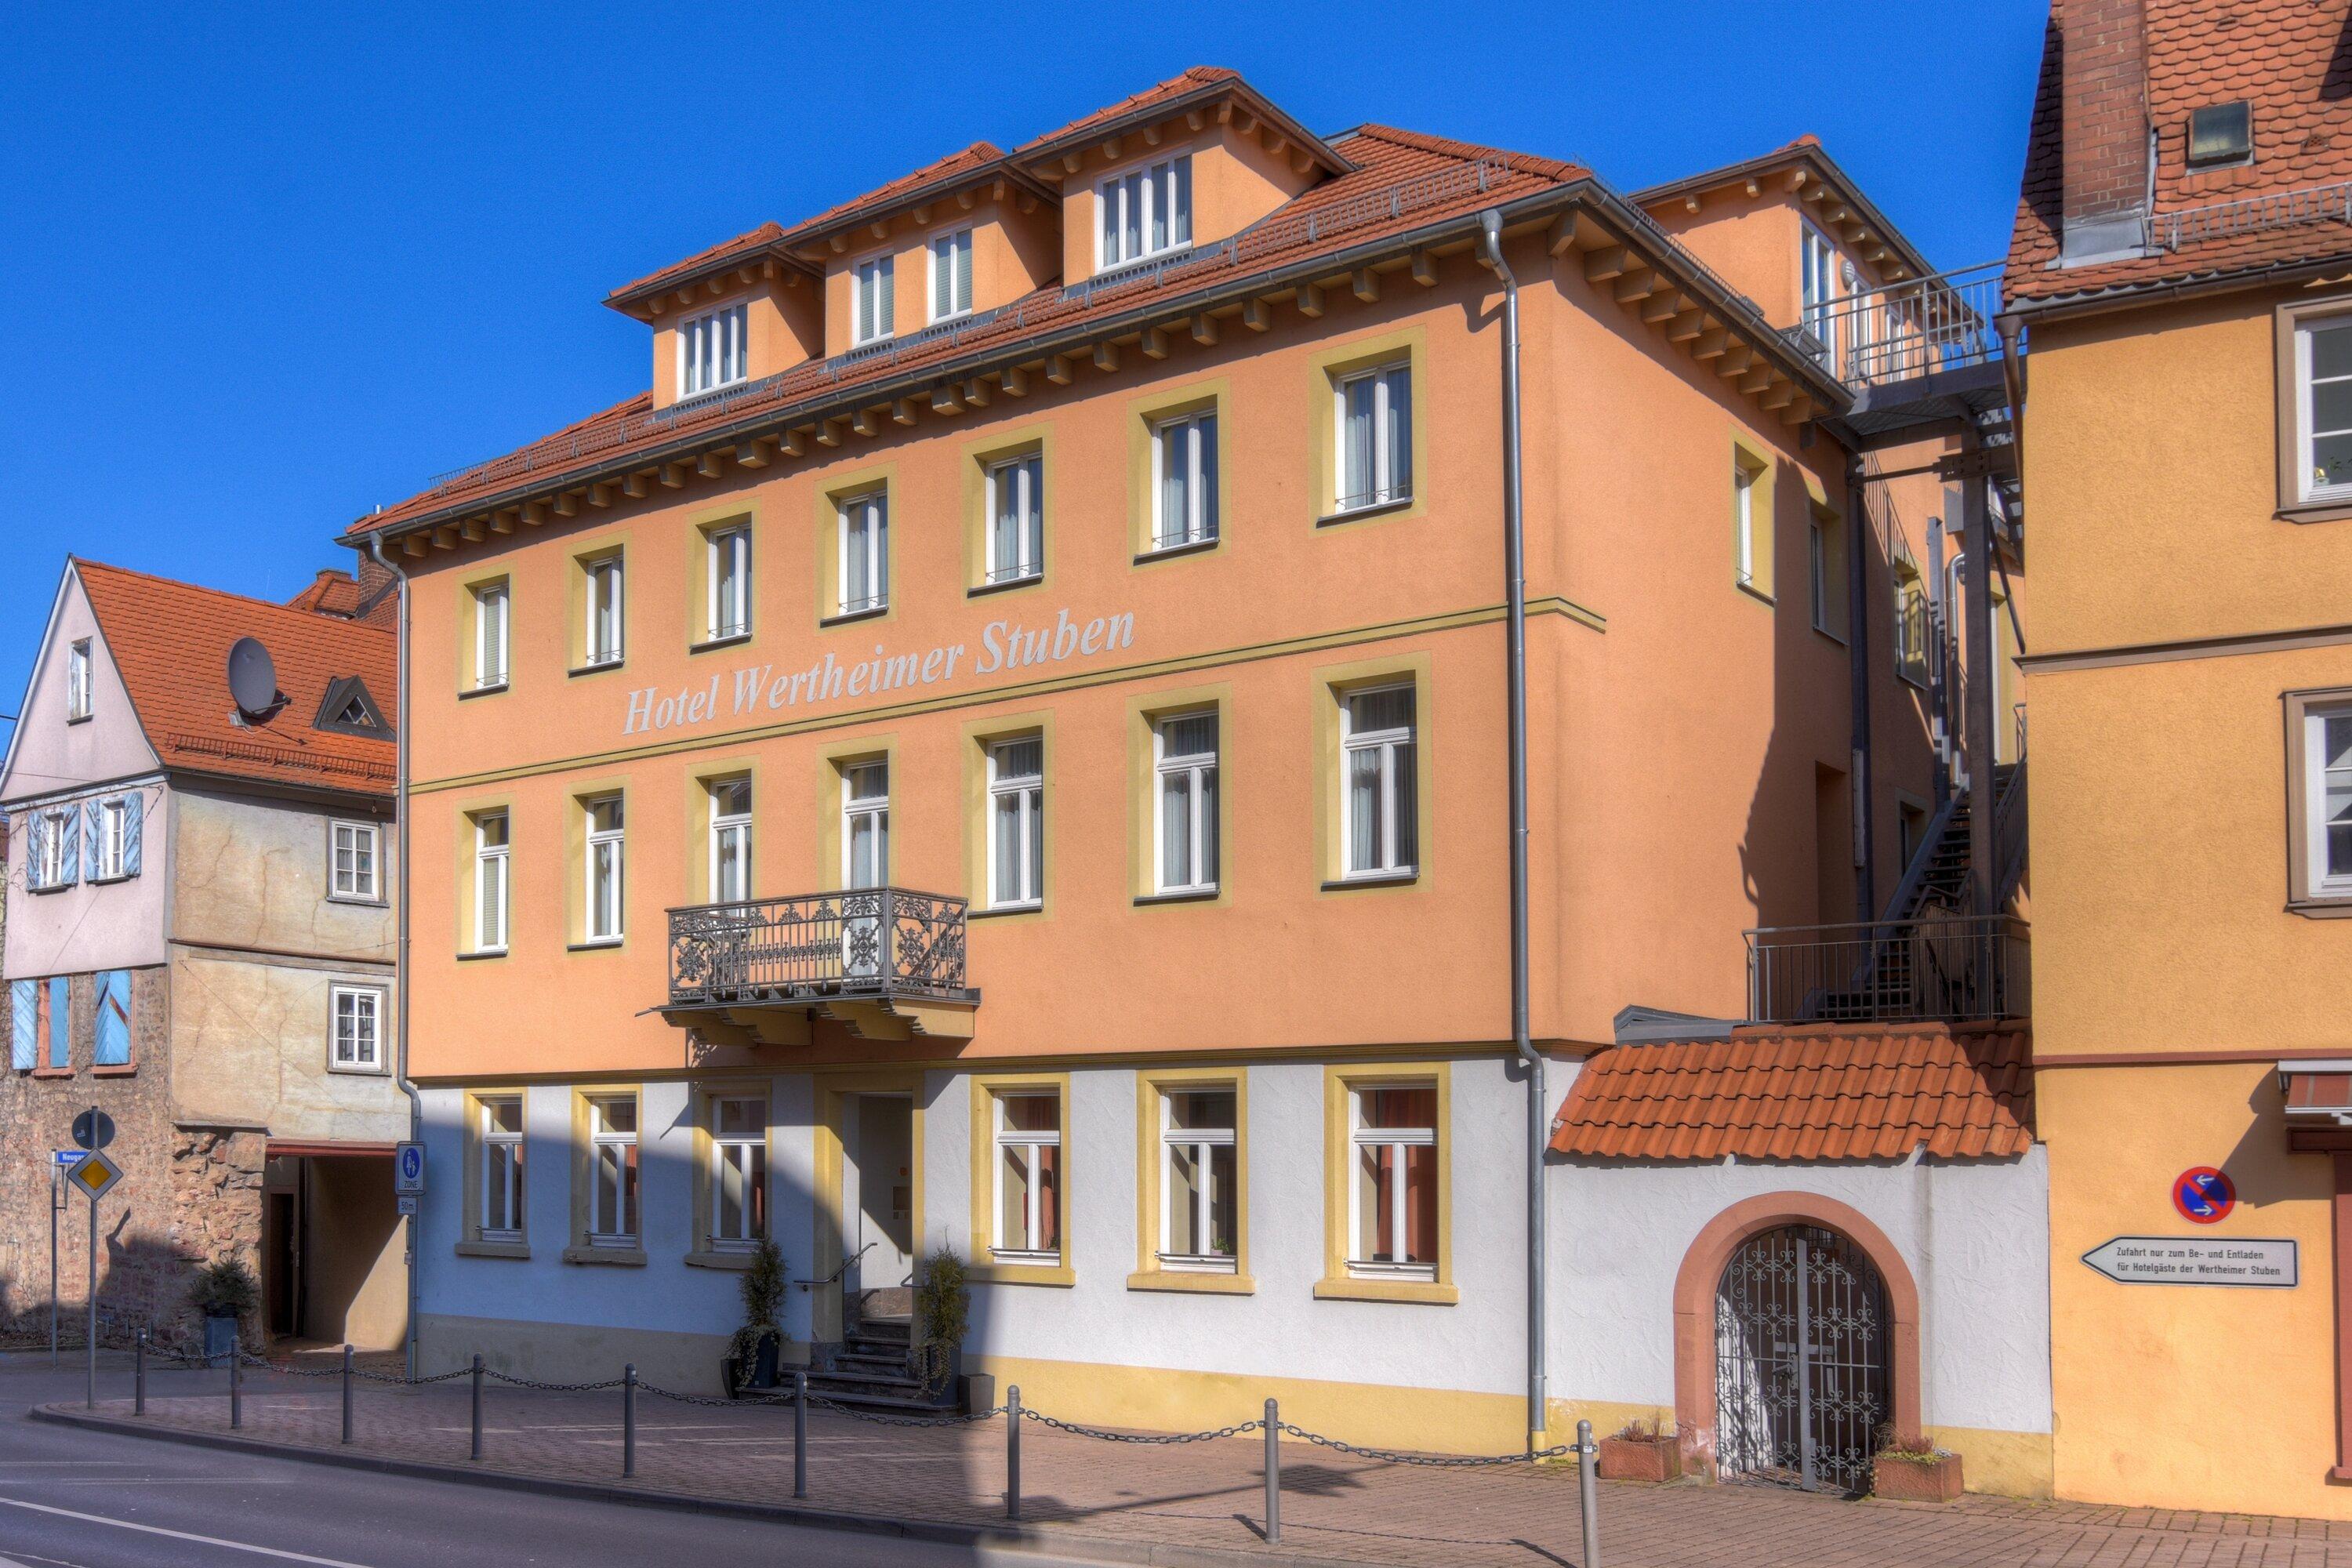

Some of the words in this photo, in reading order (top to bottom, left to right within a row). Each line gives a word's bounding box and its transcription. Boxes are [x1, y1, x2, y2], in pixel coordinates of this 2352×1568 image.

[622, 673, 720, 735] Hotel
[733, 644, 965, 716] Wertheimer
[975, 608, 1134, 675] Stuben
[2117, 1247, 2147, 1256] Zufahrt
[2188, 1249, 2205, 1258] Be-
[2208, 1250, 2223, 1258] und
[2227, 1250, 2264, 1259] Entladen
[2117, 1262, 2129, 1271] für
[2132, 1263, 2176, 1274] Hotelgäste
[2180, 1265, 2194, 1273] der
[2198, 1265, 2247, 1275] Wertheimer
[2251, 1265, 2281, 1276] Stuben
